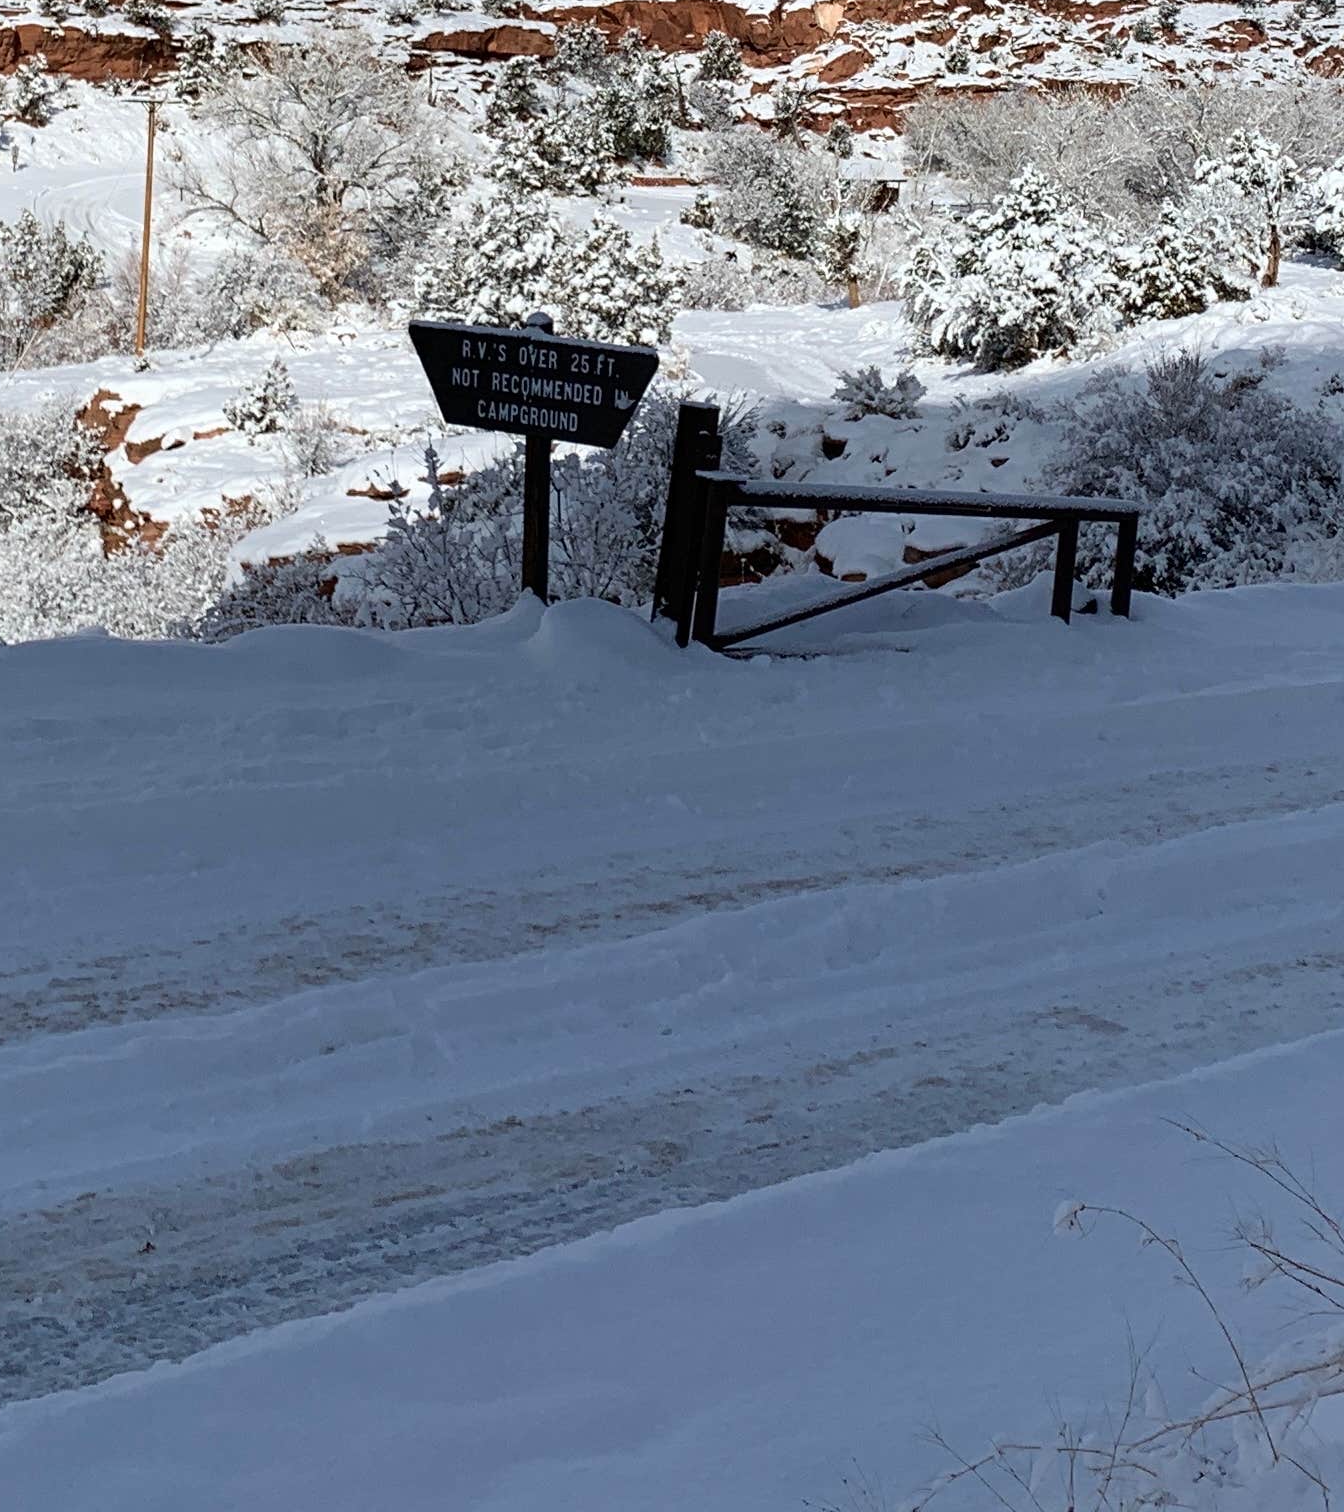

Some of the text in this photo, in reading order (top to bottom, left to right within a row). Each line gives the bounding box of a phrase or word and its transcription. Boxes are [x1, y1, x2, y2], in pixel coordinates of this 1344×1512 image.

[462, 340, 506, 363] R.V.'S
[519, 344, 557, 370] OVER
[452, 367, 480, 388] NOT
[492, 371, 602, 406] RECOMMENDED
[477, 399, 578, 432] CAMPGROUND
